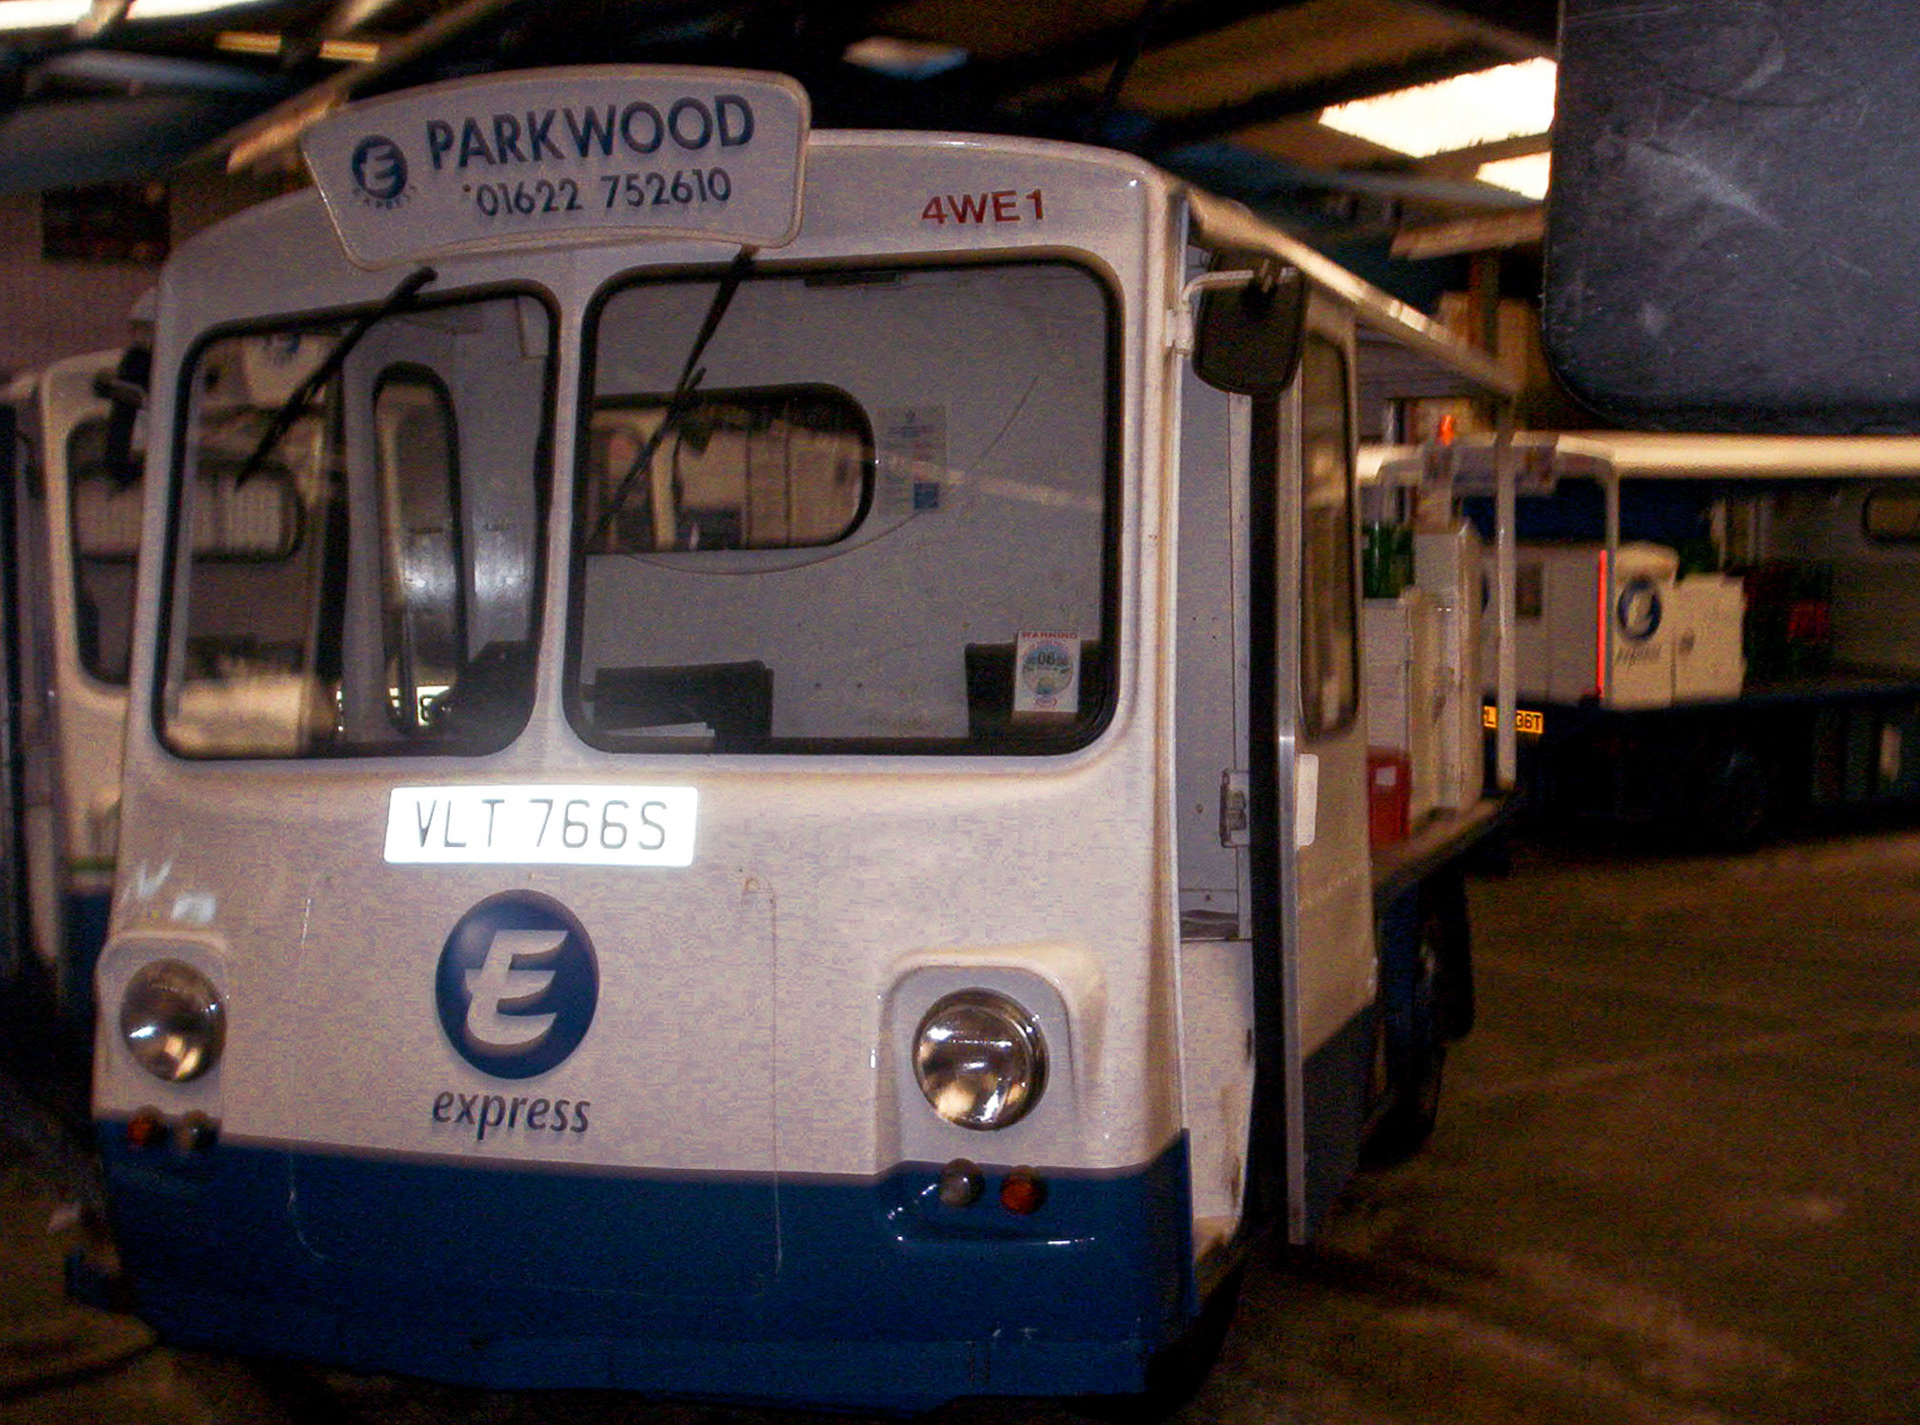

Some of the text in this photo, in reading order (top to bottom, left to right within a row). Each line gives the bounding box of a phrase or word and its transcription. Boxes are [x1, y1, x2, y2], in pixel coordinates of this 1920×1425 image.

[426, 94, 755, 169] PARKWOOD
[476, 166, 732, 217] 01622 752610
[921, 189, 1044, 225] 4WE1
[416, 799, 668, 850] VLT 766S
[432, 1091, 592, 1141] express
